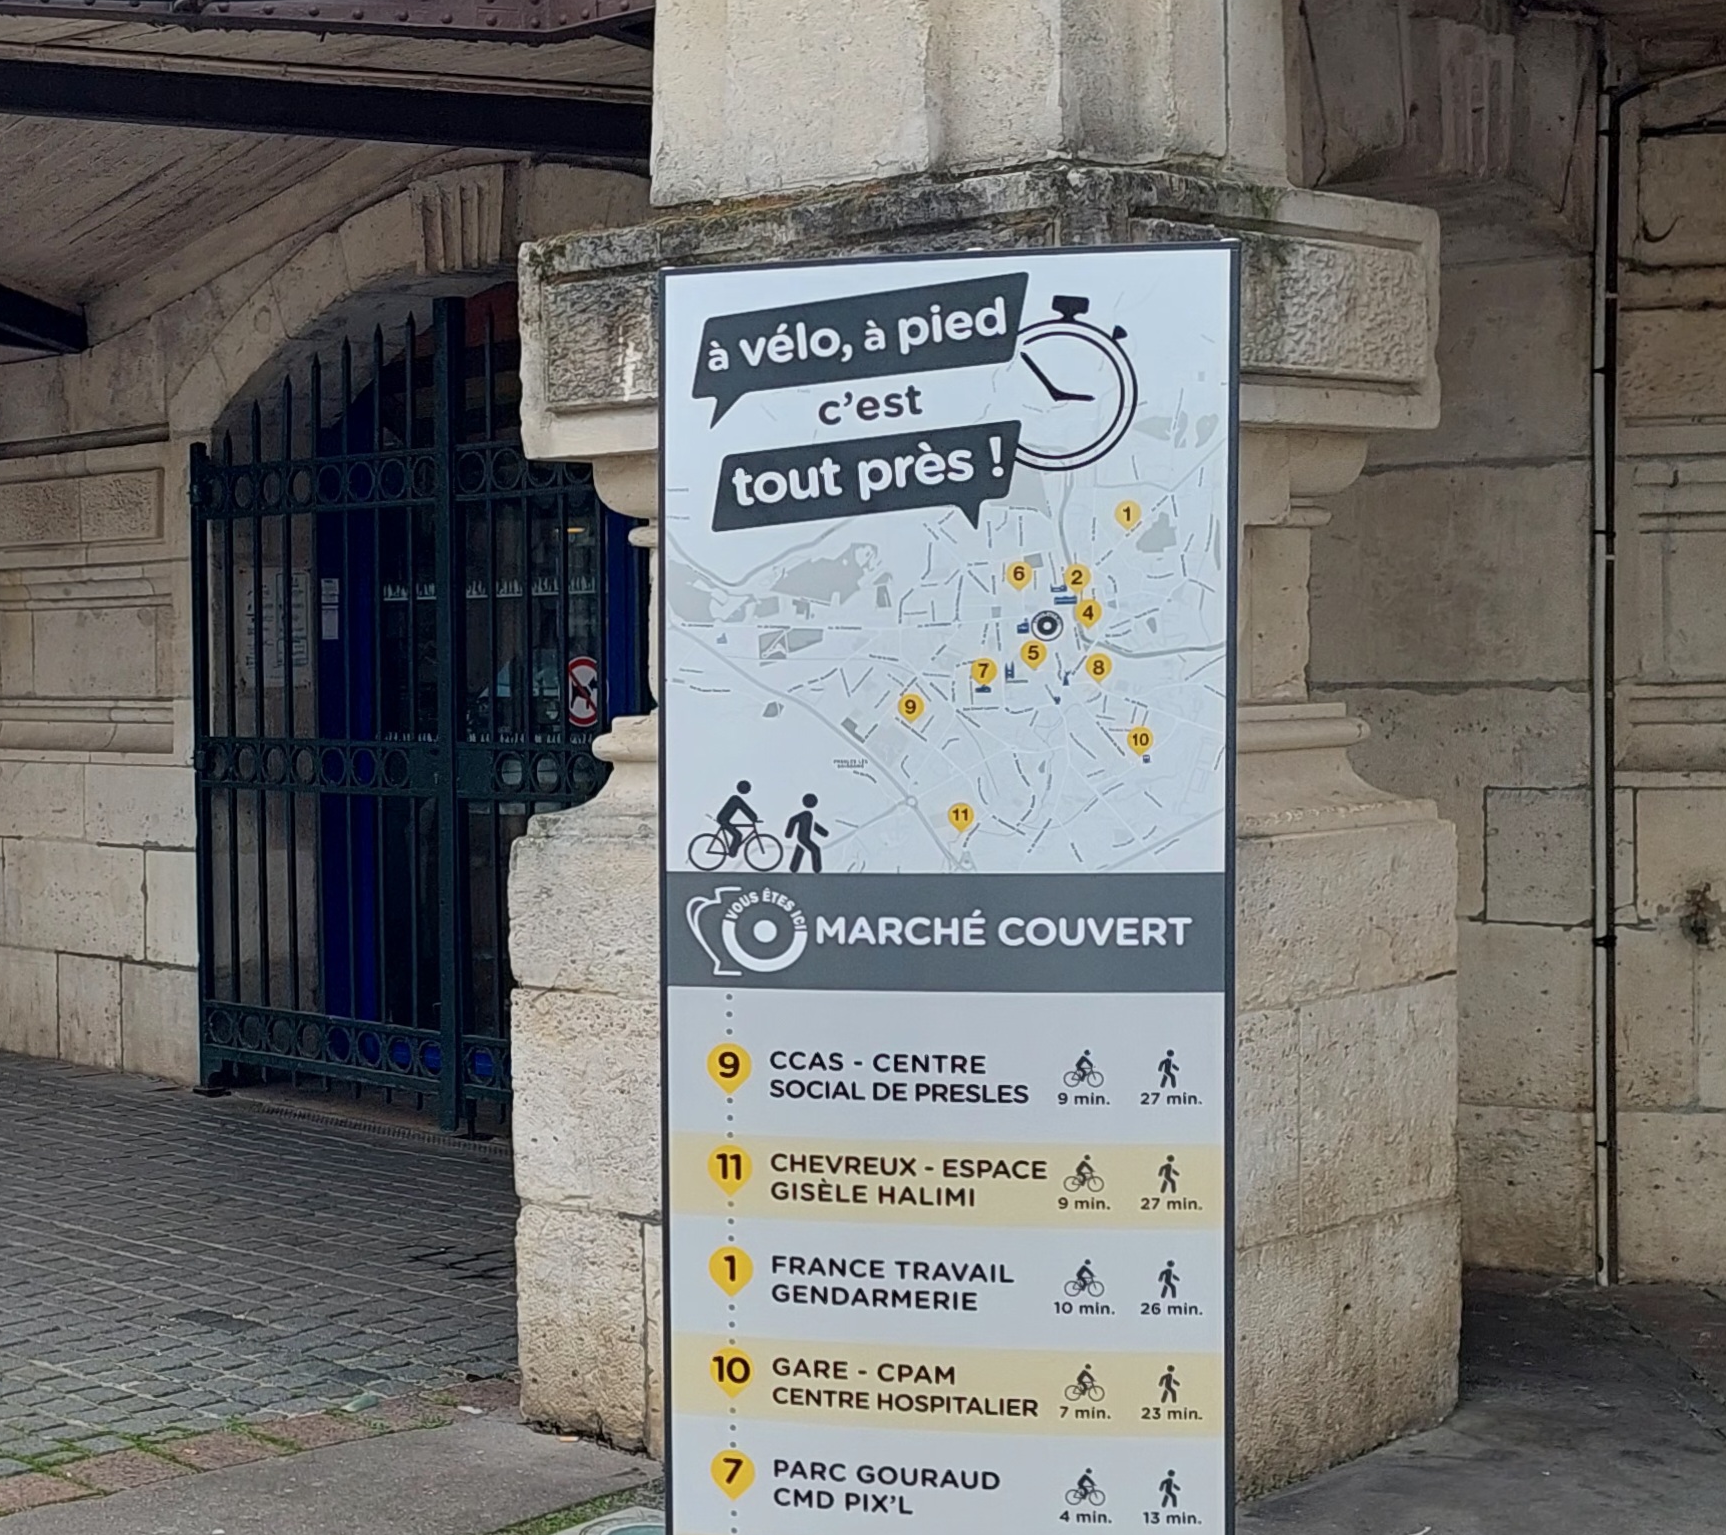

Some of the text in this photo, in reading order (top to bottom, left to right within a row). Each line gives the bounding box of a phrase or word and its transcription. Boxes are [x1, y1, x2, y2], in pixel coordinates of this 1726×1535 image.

[709, 297, 1006, 371] à vélo, à pied
[732, 437, 1003, 505] tout près !
[1123, 507, 1130, 521] 1
[1014, 566, 1025, 581] 6
[1071, 570, 1082, 585] 2
[1083, 605, 1093, 620] 4
[1028, 646, 1039, 660] 5
[978, 663, 989, 678] 7
[1093, 660, 1104, 675] 8
[905, 699, 916, 714] 9
[1133, 733, 1149, 746] 10
[953, 809, 967, 821] 11
[725, 887, 807, 930] VOUS ÊTES ICI
[817, 910, 1192, 946] MARCHÉ COUVERT
[719, 1052, 739, 1078] 9
[770, 1051, 843, 1071] CCAS
[873, 1054, 985, 1074] CENTRE
[770, 1080, 1028, 1103] SOCIAL DE PRESLES
[1058, 1093, 1109, 1105] 9 min.
[1141, 1092, 1202, 1104] 27 min.
[717, 1153, 741, 1180] 11
[771, 1154, 916, 1176] CHEVREUX
[943, 1159, 1047, 1179] ESPACE
[771, 1178, 974, 1206] GISÈLE HALIMI
[1058, 1197, 1110, 1210] 9 min.
[1141, 1198, 1202, 1210] 27 min.
[724, 1256, 735, 1281] 1
[773, 1256, 1014, 1283] FRANCE TRAVAIL
[772, 1284, 977, 1311] GENDARMERIE
[1054, 1302, 1114, 1314] 10 min.
[1141, 1303, 1202, 1315] 26 min.
[713, 1356, 750, 1383] 10
[773, 1358, 847, 1379] GARE
[878, 1364, 954, 1384] CPAM
[773, 1387, 1038, 1416] CENTRE HOSPITALIER
[1060, 1406, 1110, 1419] 7 min.
[1142, 1407, 1202, 1419] 23 min.
[724, 1458, 743, 1483] 7
[774, 1460, 1000, 1489] PARC GOURAUD
[774, 1488, 834, 1509] CMD
[1060, 1511, 1111, 1523] 4 min.
[1143, 1512, 1201, 1524] 13 min.
